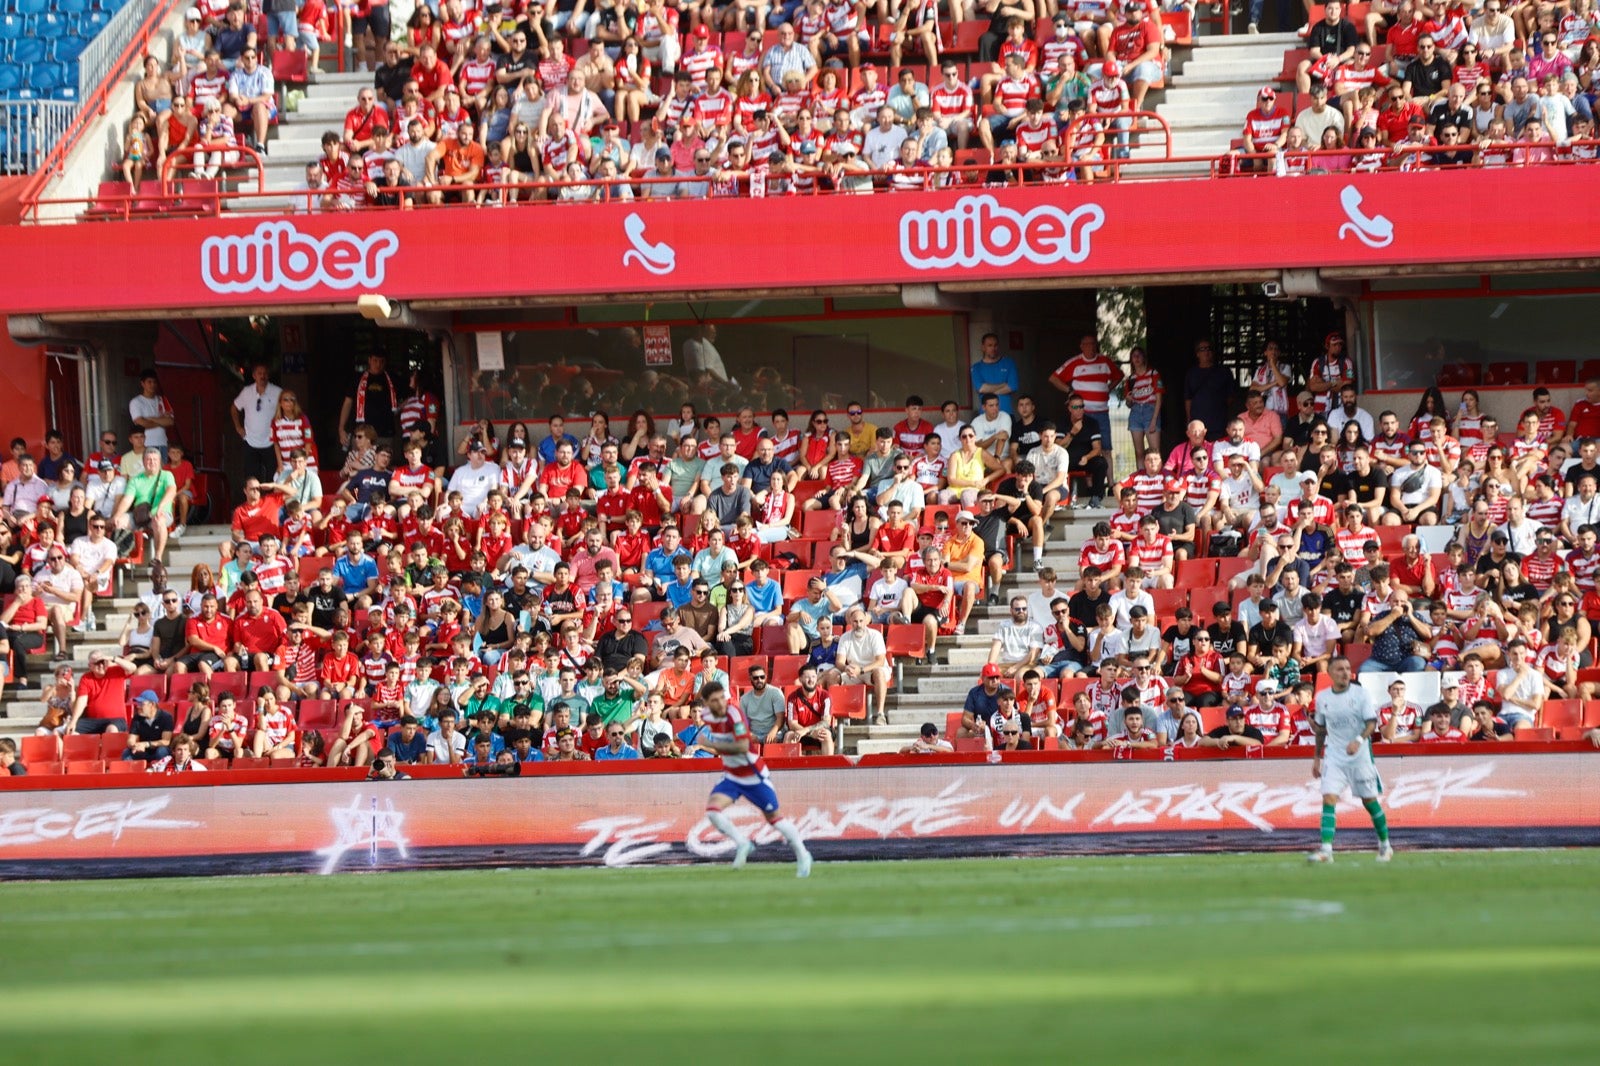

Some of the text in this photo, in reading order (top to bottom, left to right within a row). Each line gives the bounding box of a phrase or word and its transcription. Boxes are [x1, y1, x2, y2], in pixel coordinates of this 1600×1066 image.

[201, 221, 399, 294] wiber
[900, 194, 1105, 270] wiber
[362, 476, 387, 487] FILA
[1213, 639, 1234, 650] EA7
[575, 815, 677, 867] TE
[998, 792, 1086, 832] UN
